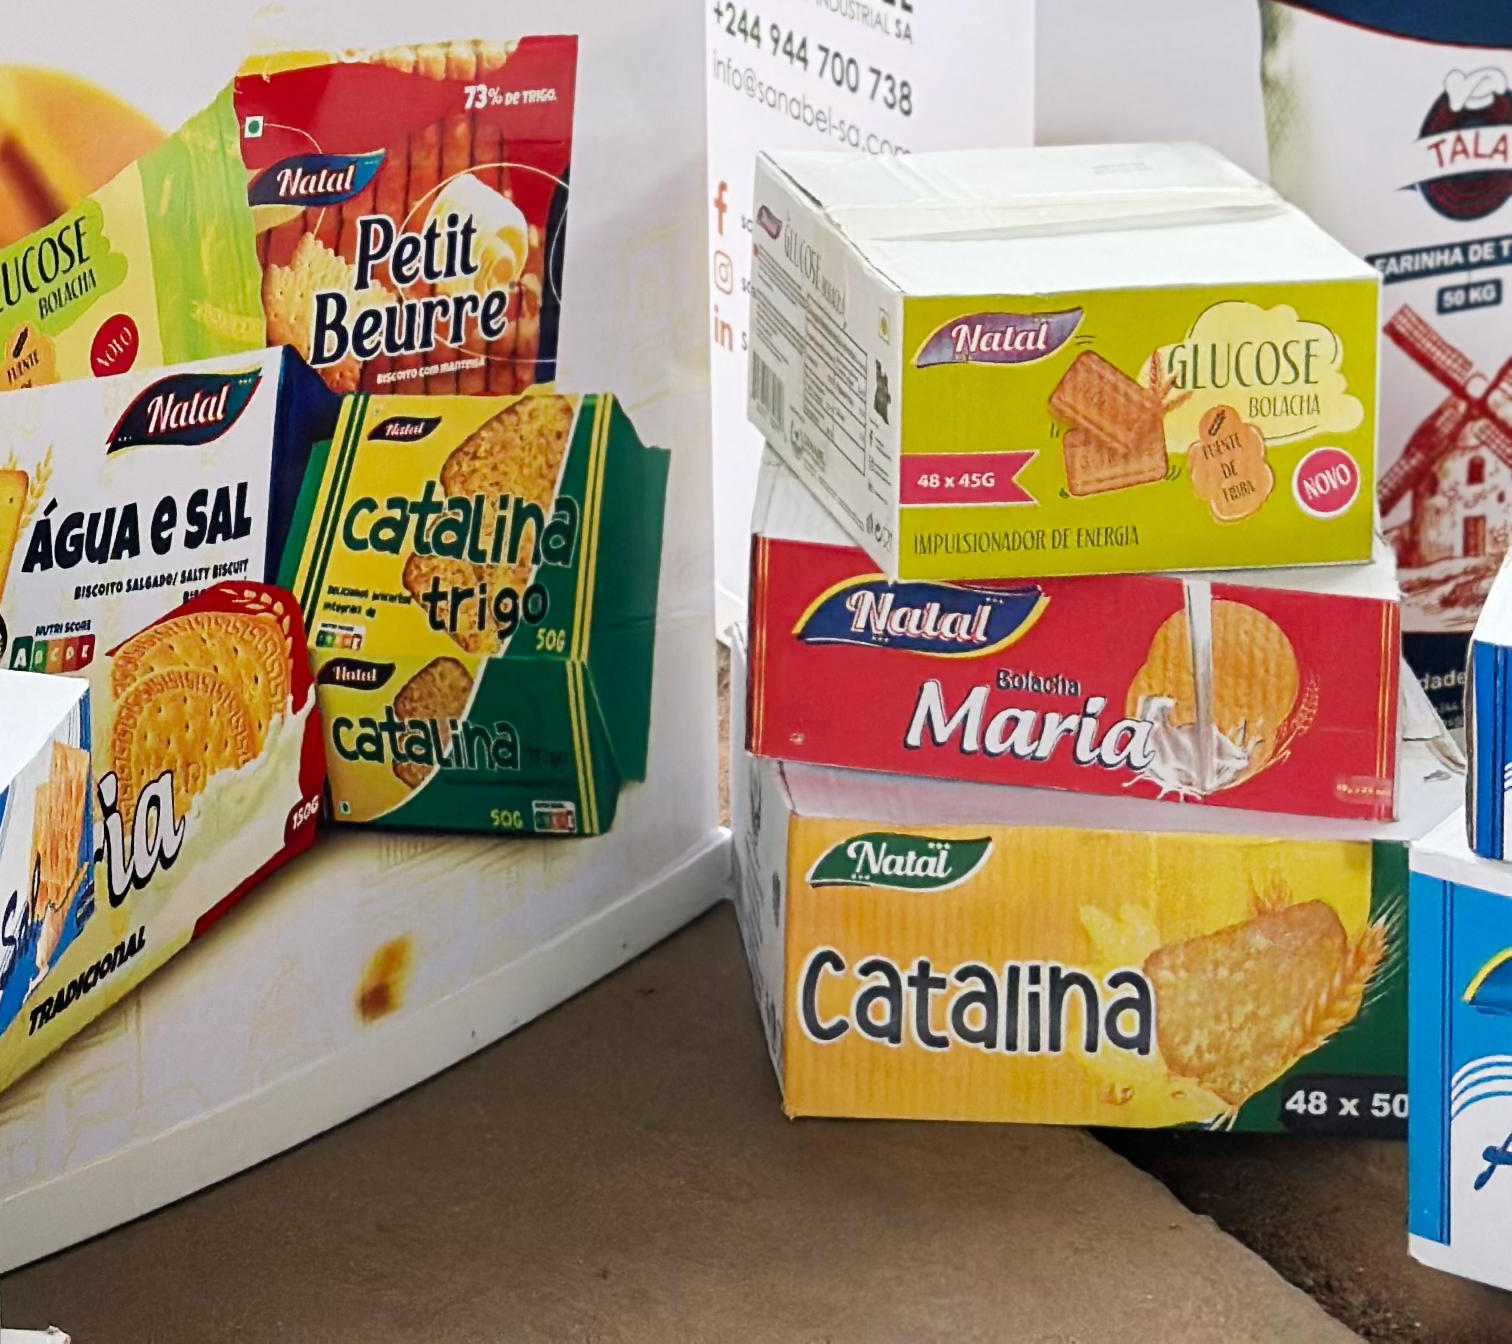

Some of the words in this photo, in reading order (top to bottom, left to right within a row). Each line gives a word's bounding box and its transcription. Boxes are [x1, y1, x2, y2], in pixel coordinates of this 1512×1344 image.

[895, 18, 913, 44] SA
[713, 0, 761, 49] +244
[769, 23, 809, 71] 944
[817, 44, 860, 94] 700
[868, 66, 914, 118] 738
[464, 83, 502, 110] 73%
[1427, 129, 1511, 169] TALA
[276, 164, 355, 197] Natal
[354, 212, 479, 291] Petit
[1467, 241, 1495, 263] DE
[38, 267, 98, 321] BOLACHA
[1442, 289, 1466, 309] 50
[1469, 283, 1496, 304] KG
[310, 289, 508, 366] Beurre
[951, 321, 1049, 354] Natal
[1168, 338, 1320, 390] GLUCOSE
[147, 383, 228, 435] Natal
[1248, 393, 1321, 418] BOLACHA
[917, 473, 941, 490] 48
[944, 477, 956, 489] x
[958, 471, 996, 489] 45G
[1220, 460, 1239, 480] DE
[1302, 463, 1351, 501] NOVO
[21, 497, 143, 574] ÁGUA
[149, 505, 178, 547] e
[186, 481, 253, 551] SAL
[343, 480, 580, 567] catalina
[913, 528, 1046, 556] IMPULSIONADOR
[1051, 528, 1072, 550] DE
[1076, 524, 1140, 549] ENERGIA
[74, 579, 124, 601] BISCOITO
[125, 572, 178, 593] SALGADO/
[180, 566, 210, 585] SALTY
[212, 558, 250, 580] BISCUIT
[421, 575, 549, 641] trigo
[845, 588, 993, 647] Natal
[35, 623, 64, 637] NUTRI
[535, 627, 566, 653] 50G
[995, 668, 1081, 698] Bolacha
[905, 678, 1157, 772] Maria
[291, 794, 320, 832] 150G
[490, 808, 524, 830] 50G
[847, 839, 953, 880] Natal
[0, 851, 43, 993] Sal
[28, 925, 147, 1036] TRADICIONAL
[801, 949, 1154, 1056] Catalina
[1285, 1090, 1329, 1117] 48
[1338, 1096, 1361, 1118] x
